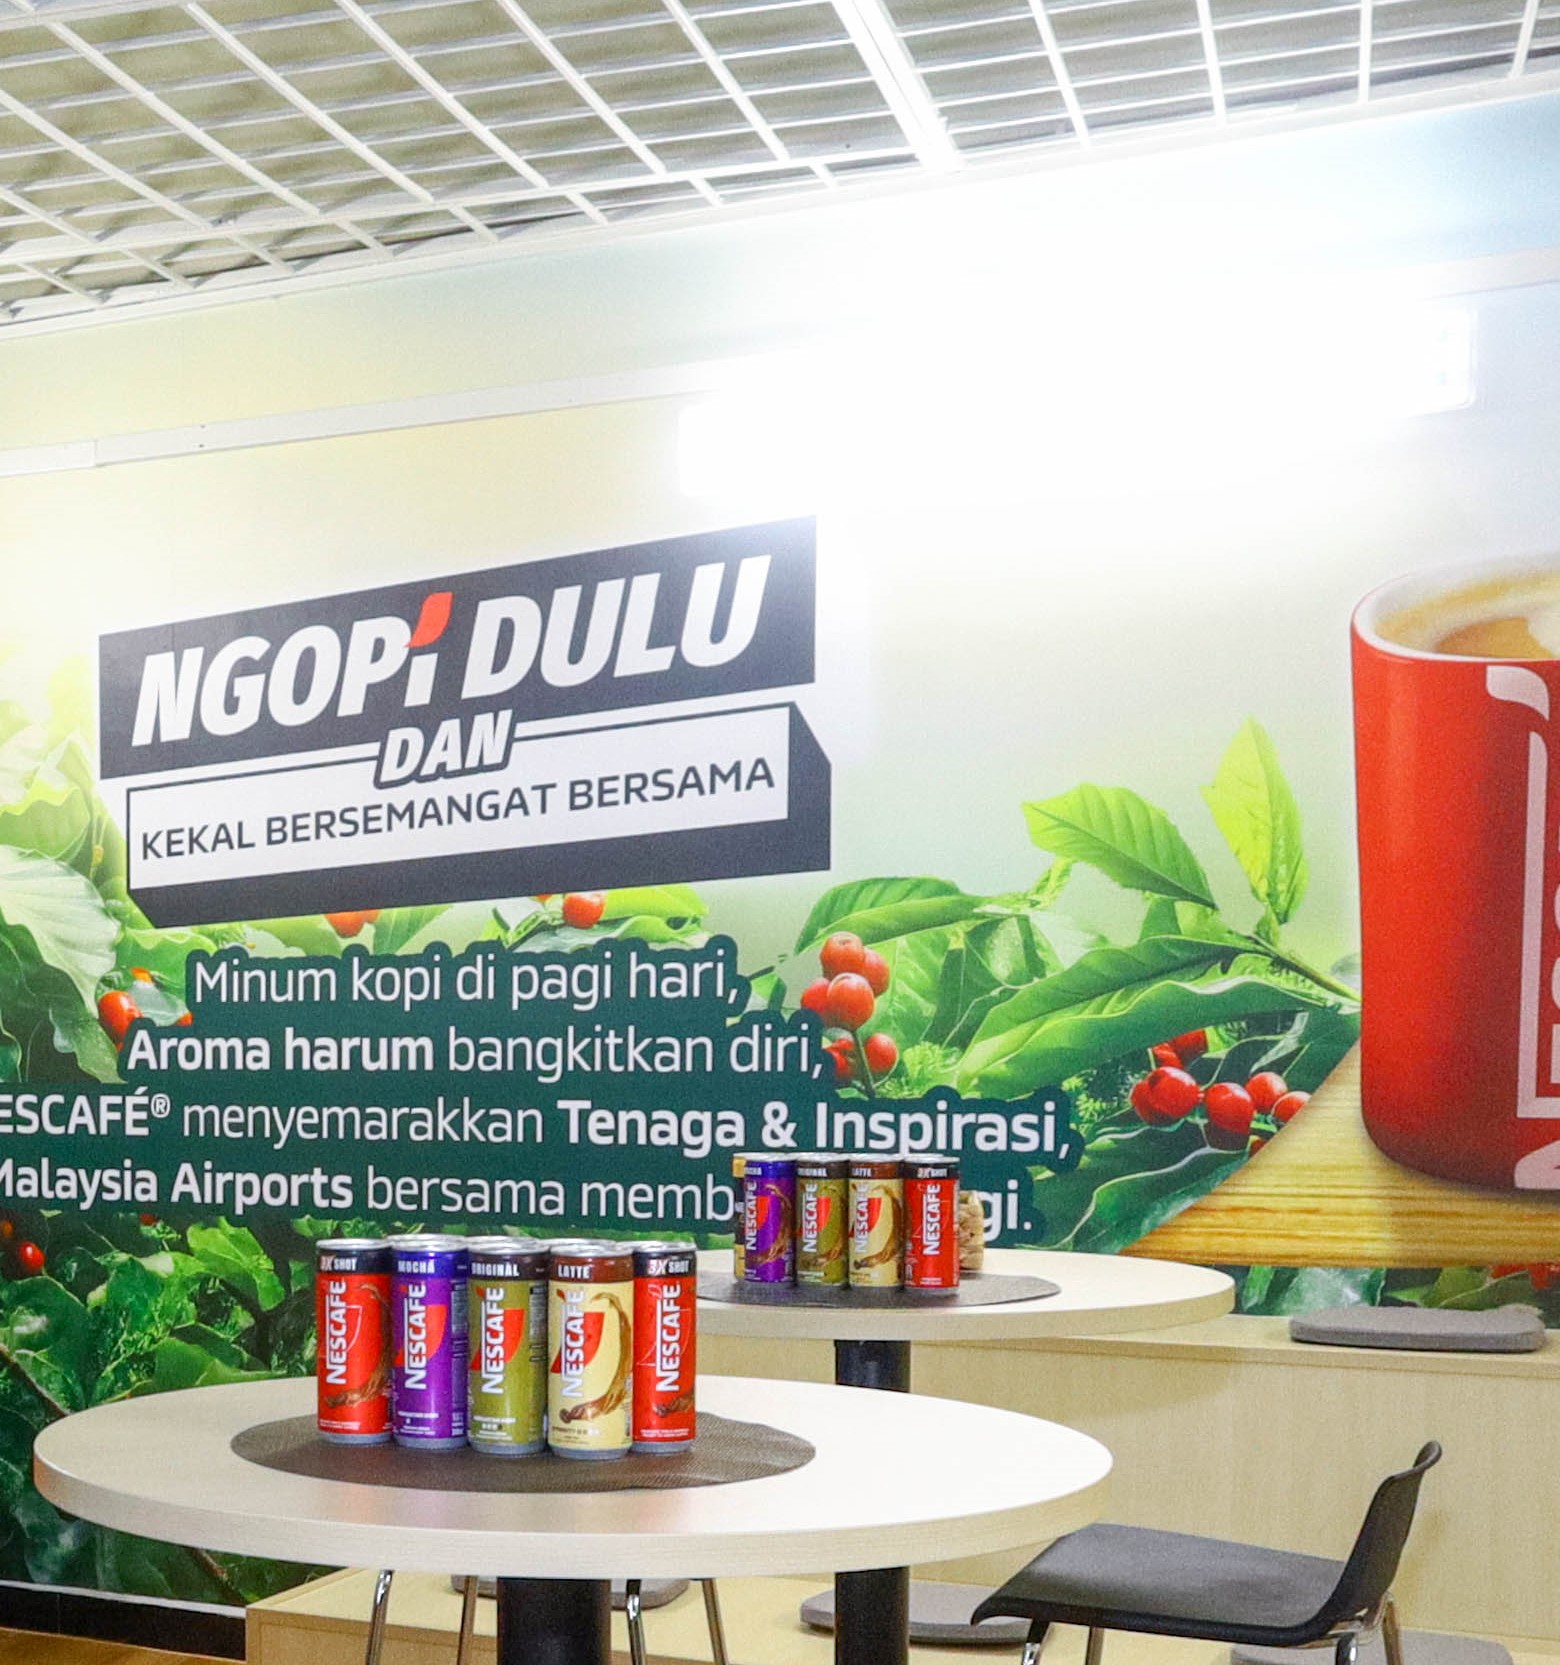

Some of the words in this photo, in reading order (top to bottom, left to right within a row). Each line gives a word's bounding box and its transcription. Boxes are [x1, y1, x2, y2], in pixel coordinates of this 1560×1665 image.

[461, 554, 772, 700] DULU
[378, 710, 513, 783] DAN
[141, 810, 256, 862] KEKAL
[265, 782, 557, 847] BERSEMANGAT
[568, 756, 776, 812] BERSAMA
[195, 960, 337, 1003] Minum
[352, 955, 441, 1012] kopi
[457, 954, 495, 1000] di
[511, 951, 613, 1011] pagi
[628, 949, 739, 1005] hari,
[127, 1030, 271, 1072] Aroma
[285, 1027, 434, 1071] harum
[448, 1024, 713, 1084] bangkitkan
[728, 1022, 824, 1080] diri,
[183, 1096, 544, 1149] menyemarakkan
[557, 1098, 746, 1159] Tenaga
[761, 1105, 798, 1150] &
[816, 1100, 1071, 1160] Inspirasi,
[171, 1161, 353, 1214] Airports
[367, 1166, 565, 1216] bersama
[333, 1257, 357, 1271] SHOT
[397, 1260, 435, 1274] MOCHA
[471, 1262, 520, 1278] ORIGINAL
[557, 1263, 590, 1279] LATTE
[668, 1258, 690, 1273] SHOT
